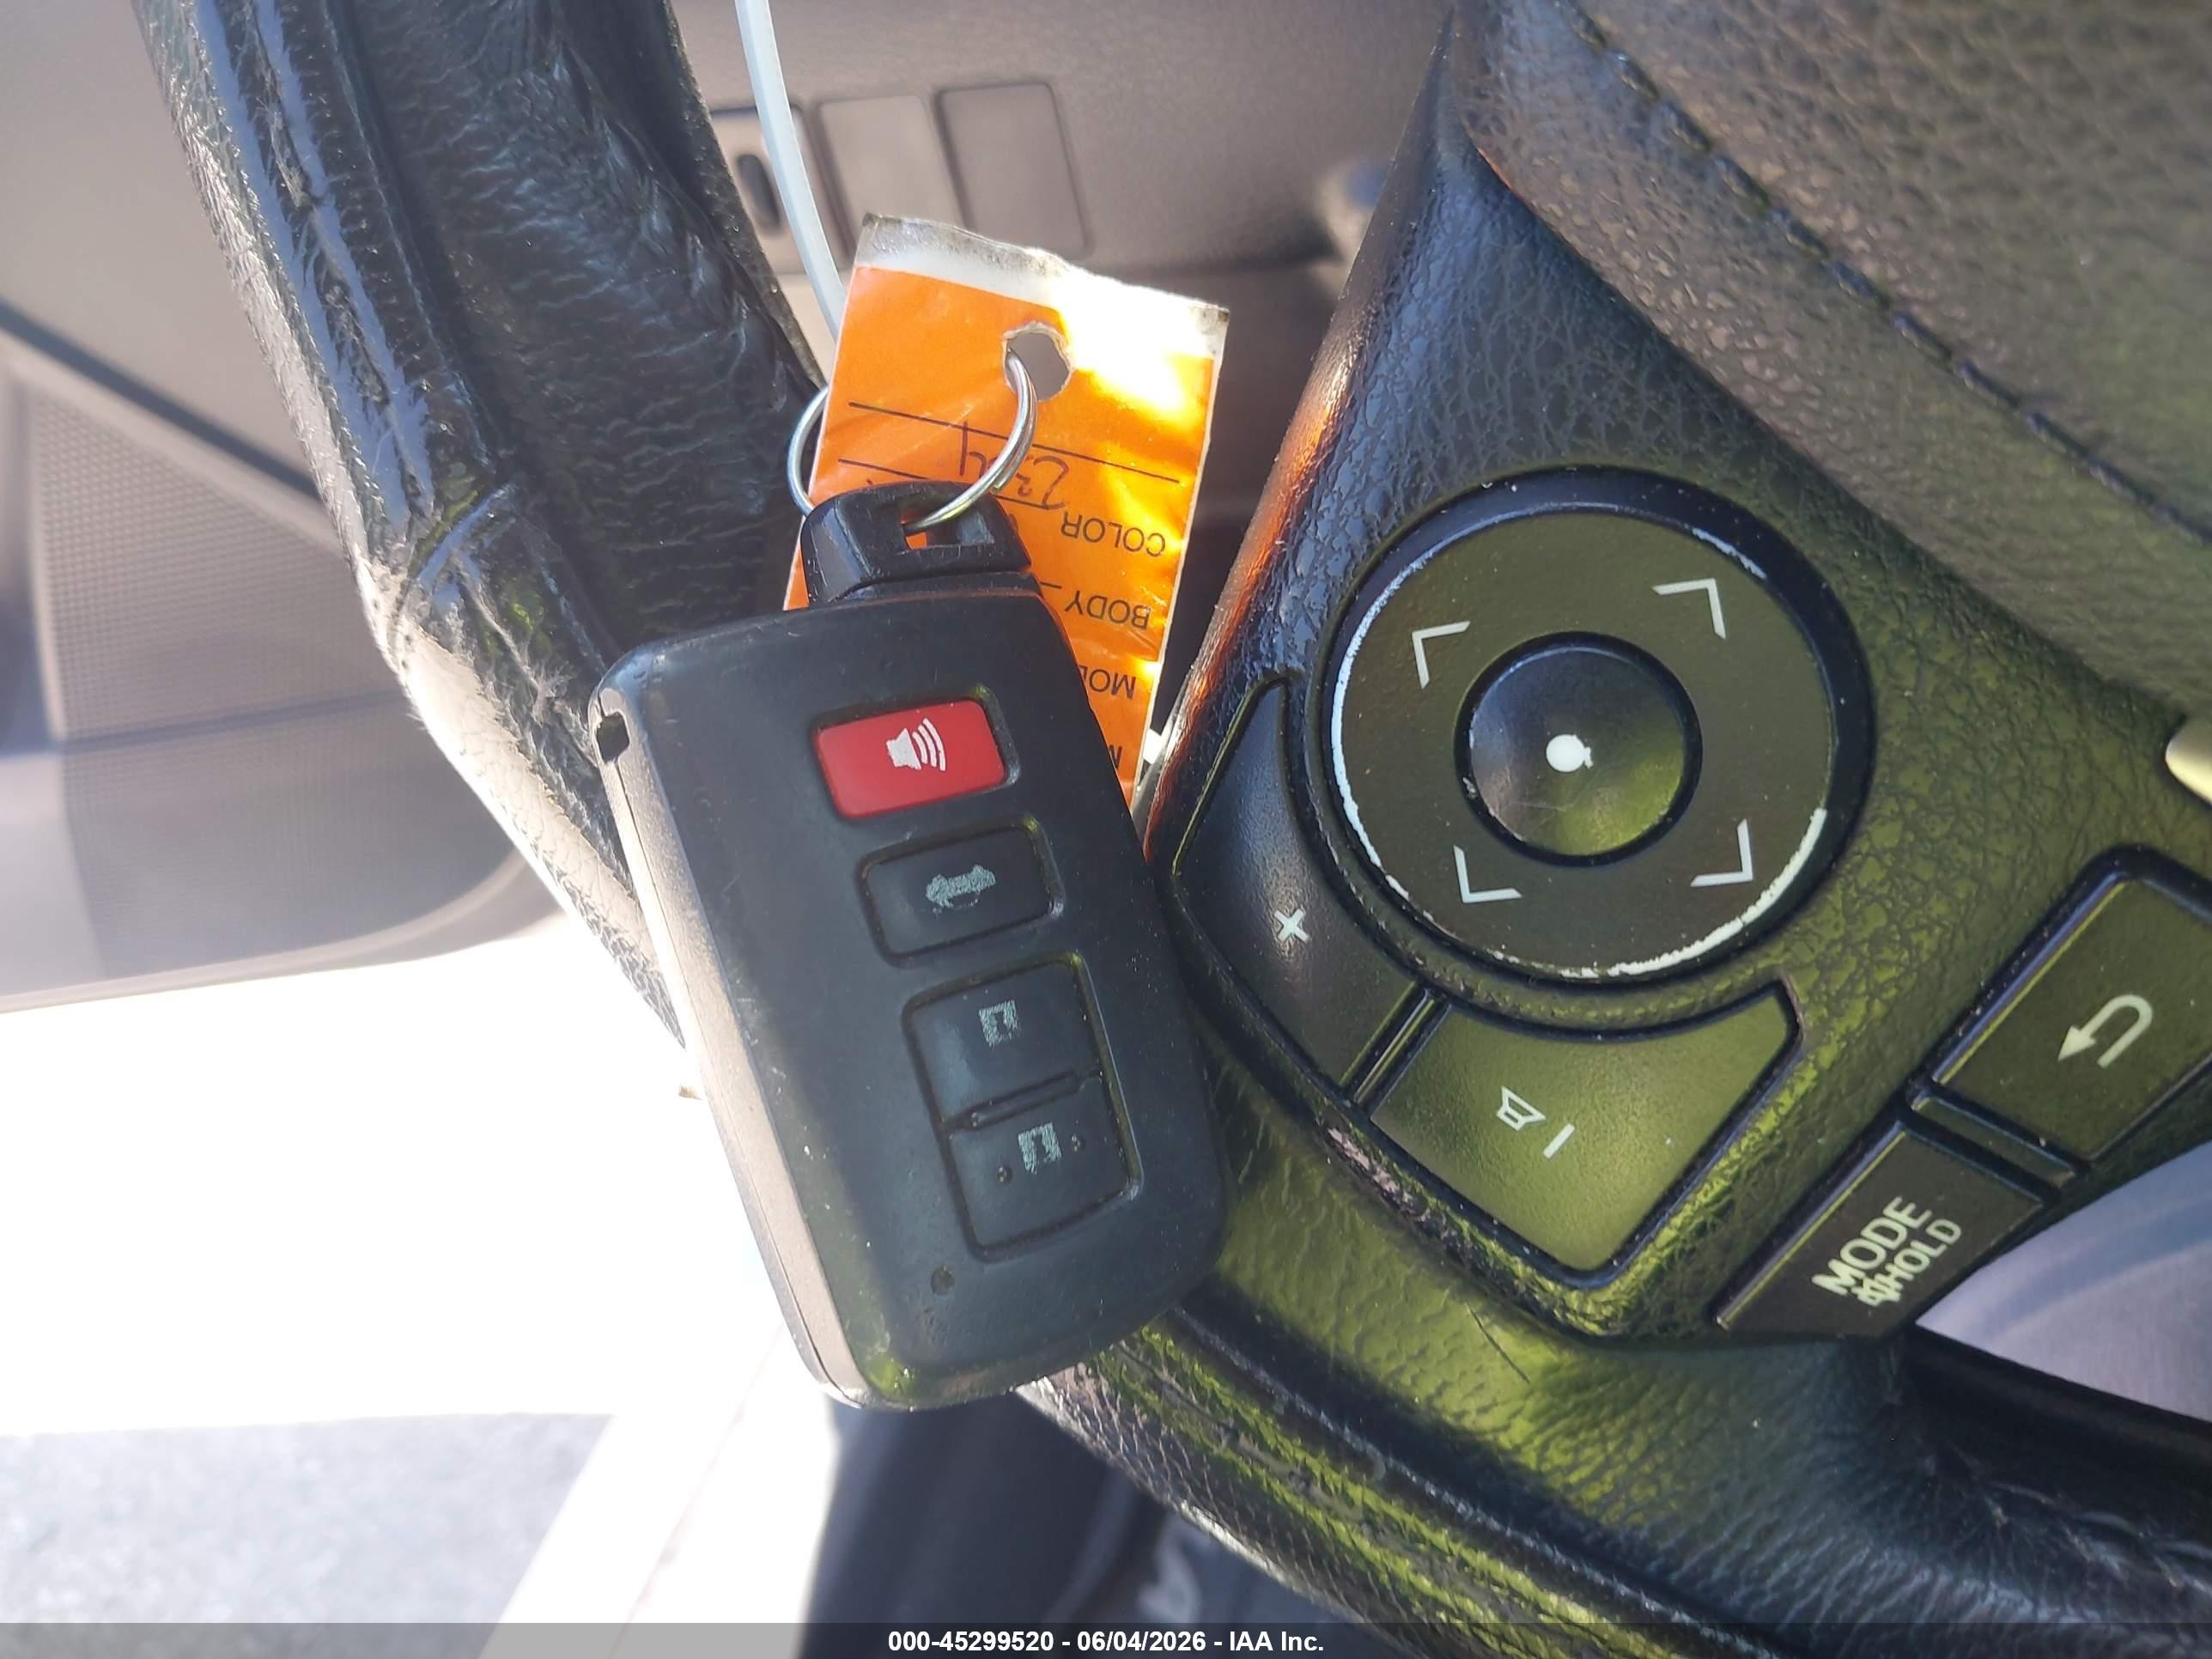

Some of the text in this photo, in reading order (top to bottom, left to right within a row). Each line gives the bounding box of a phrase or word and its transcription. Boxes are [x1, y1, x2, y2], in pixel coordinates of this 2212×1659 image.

[1060, 511, 1166, 557] COLOR
[1065, 590, 1151, 630] BODY
[1811, 1196, 1932, 1296] MODE
[1875, 1218, 1962, 1291] HOLD
